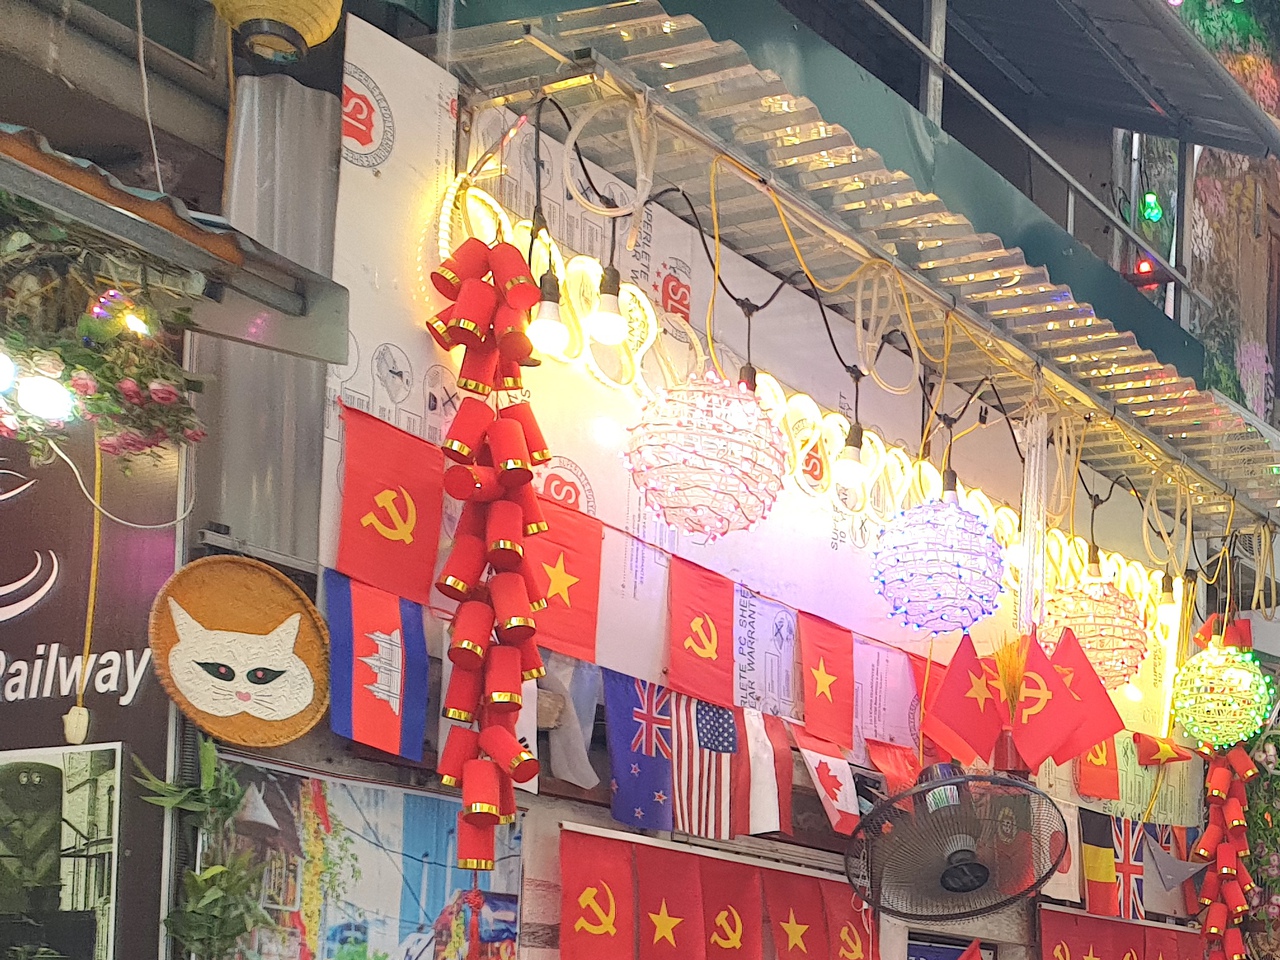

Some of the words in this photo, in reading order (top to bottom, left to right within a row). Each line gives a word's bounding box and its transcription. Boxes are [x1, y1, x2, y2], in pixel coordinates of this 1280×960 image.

[738, 635, 747, 657] PC
[747, 587, 758, 672] WARRANTY
[739, 662, 748, 709] RLETE
